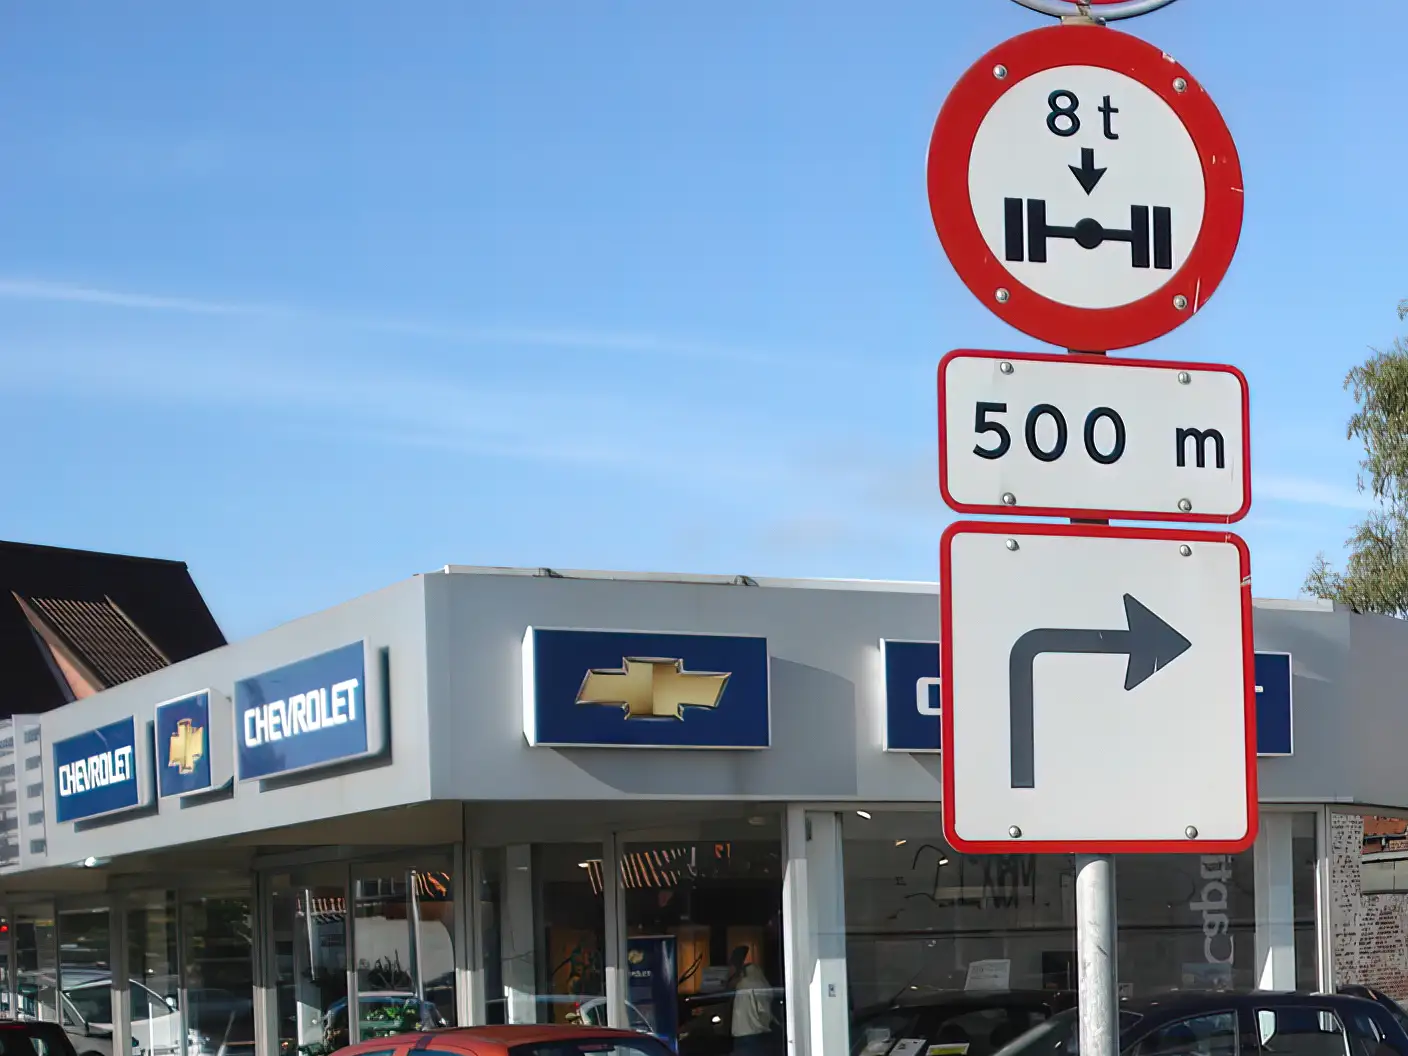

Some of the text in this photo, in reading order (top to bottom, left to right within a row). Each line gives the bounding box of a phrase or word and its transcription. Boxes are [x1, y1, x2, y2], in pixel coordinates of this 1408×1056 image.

[1046, 89, 1119, 140] 8 t
[972, 401, 1225, 468] 500 m
[242, 677, 360, 748] CHEVROLET
[58, 744, 133, 797] CHEVROLET
